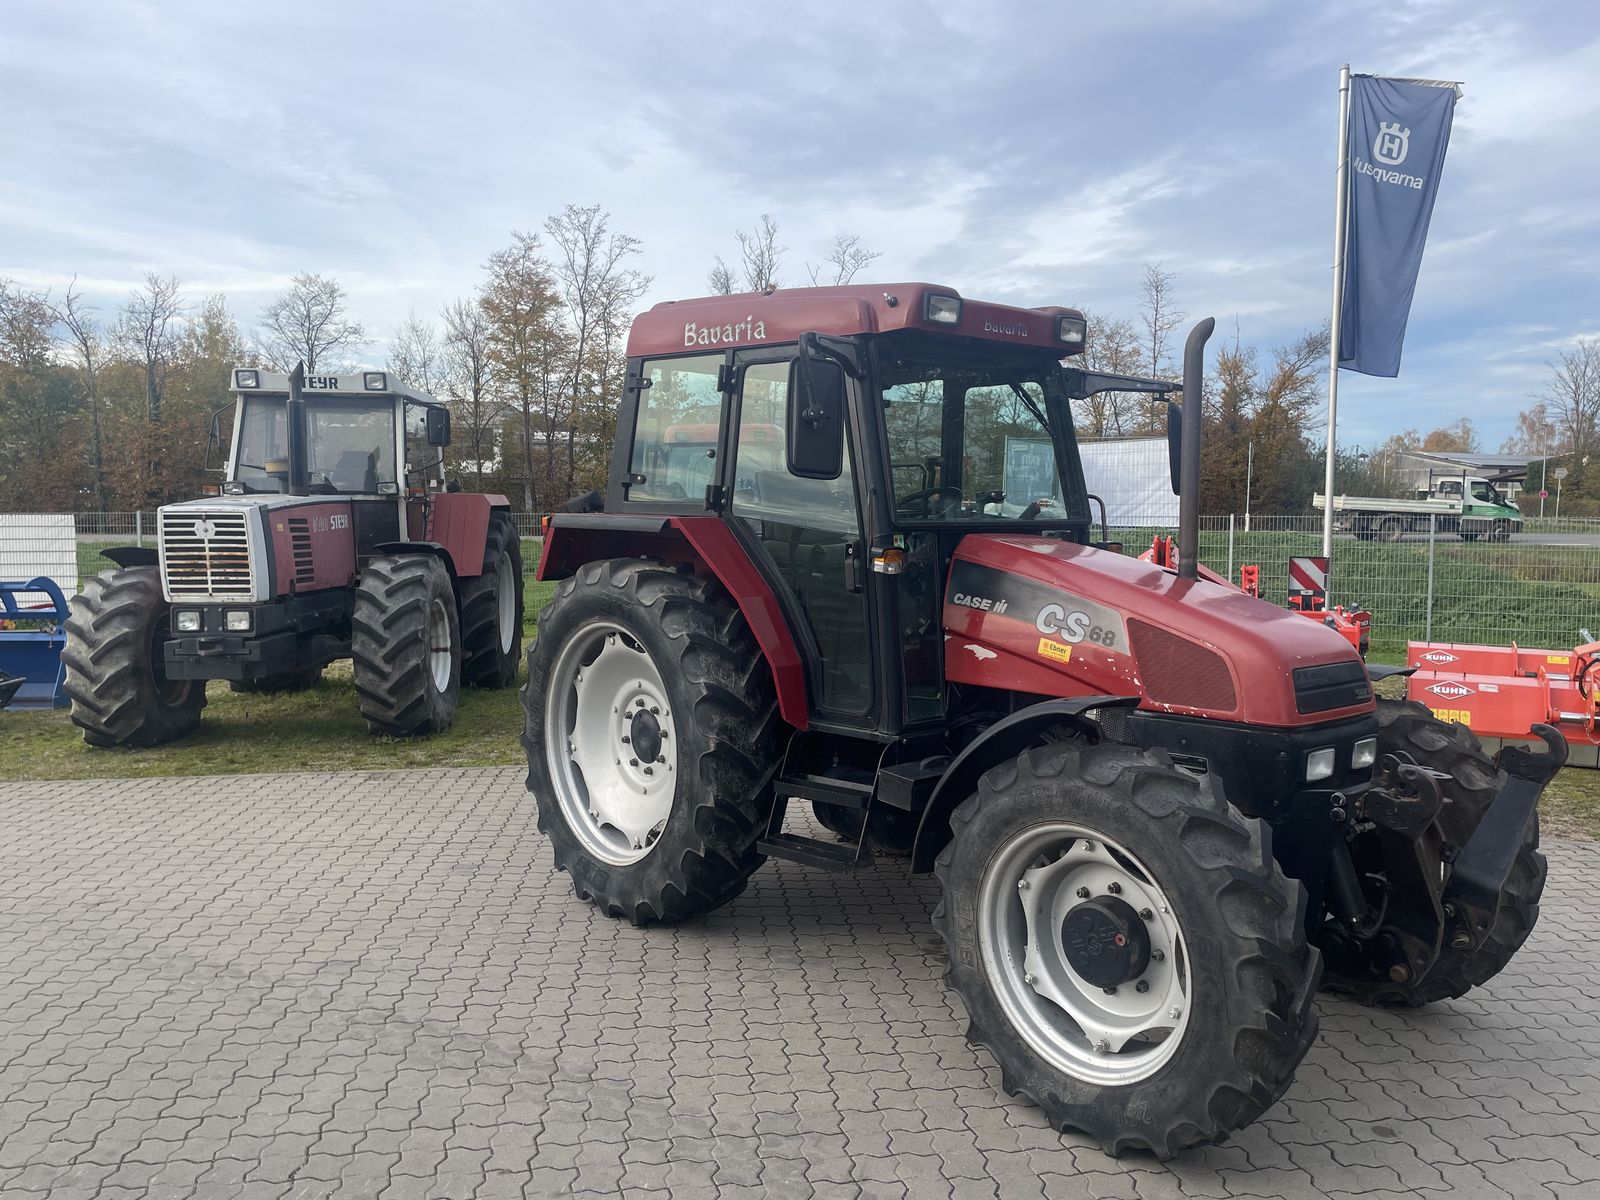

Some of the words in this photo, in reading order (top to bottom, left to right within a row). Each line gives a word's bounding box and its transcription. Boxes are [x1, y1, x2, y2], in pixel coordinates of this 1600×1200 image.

[684, 314, 766, 347] Bavaria
[984, 317, 1028, 337] Bavaria
[302, 376, 338, 389] TEYR
[330, 515, 349, 530] STEYR
[953, 593, 992, 611] CASE
[1035, 603, 1090, 644] CS
[1088, 625, 1116, 647] 68
[1433, 686, 1467, 695] KUHN
